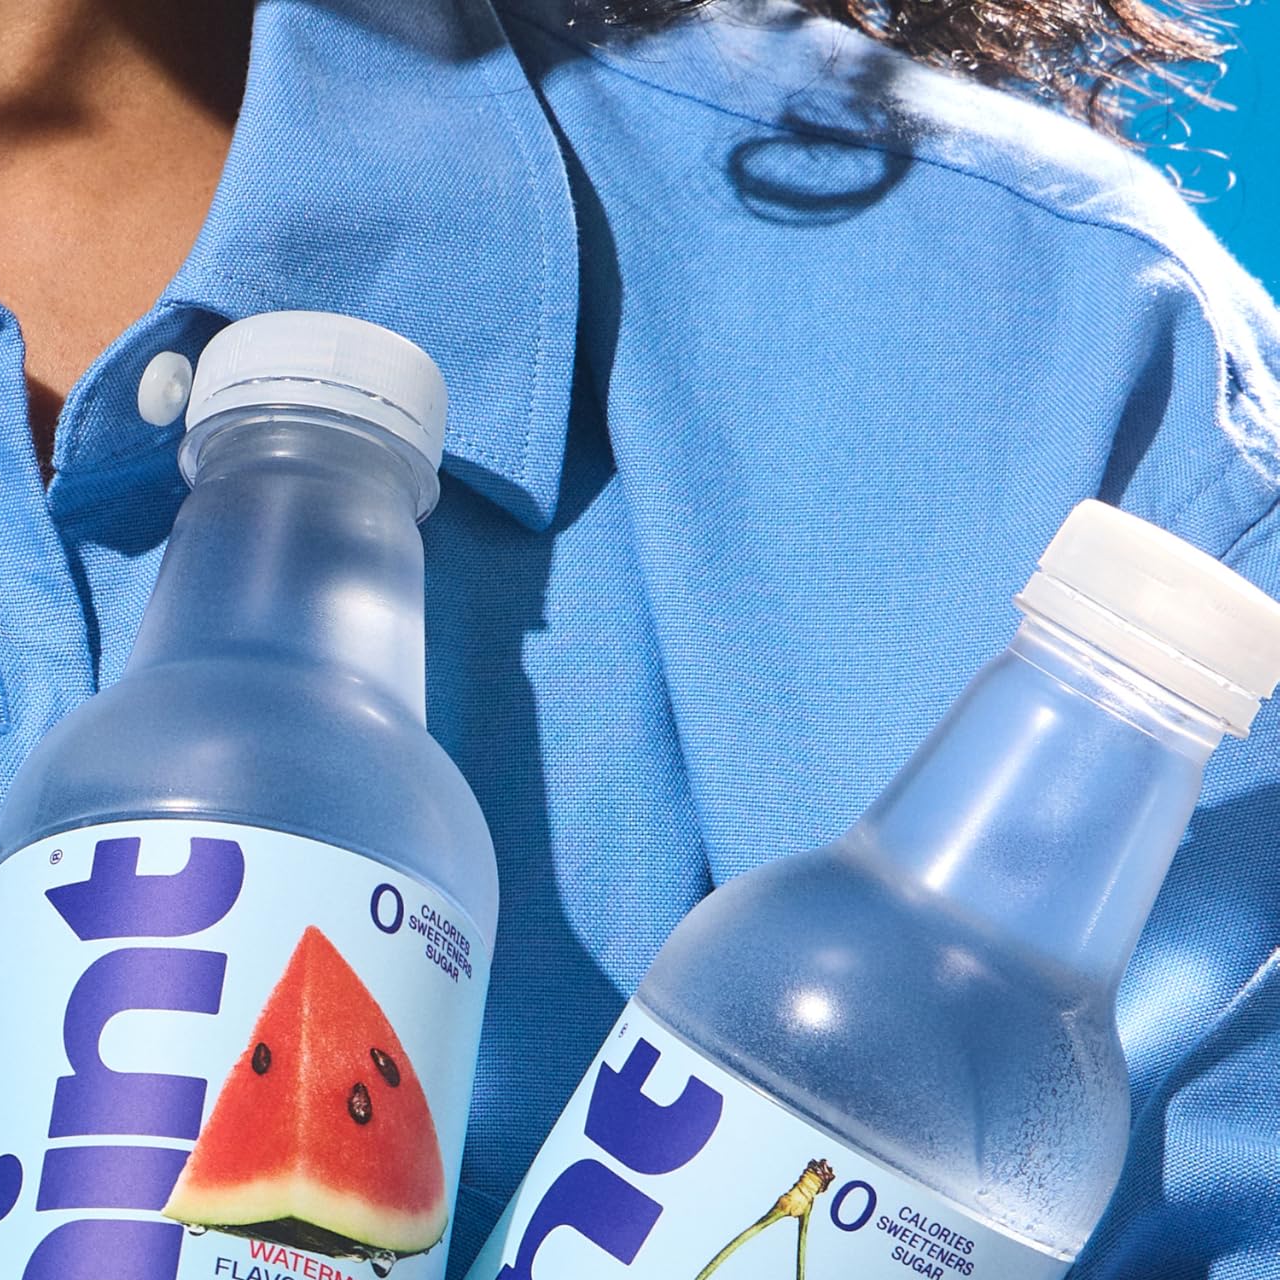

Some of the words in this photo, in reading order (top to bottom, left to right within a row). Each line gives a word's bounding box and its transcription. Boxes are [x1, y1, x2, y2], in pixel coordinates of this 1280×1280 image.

[370, 883, 404, 934] 0
[421, 904, 470, 956] CALORIES
[407, 915, 472, 979] SWEETENERS
[425, 944, 459, 983] SUGAR
[830, 1180, 877, 1232] 0
[899, 1206, 975, 1255] CALORIES
[876, 1216, 975, 1276] SWEETENERS
